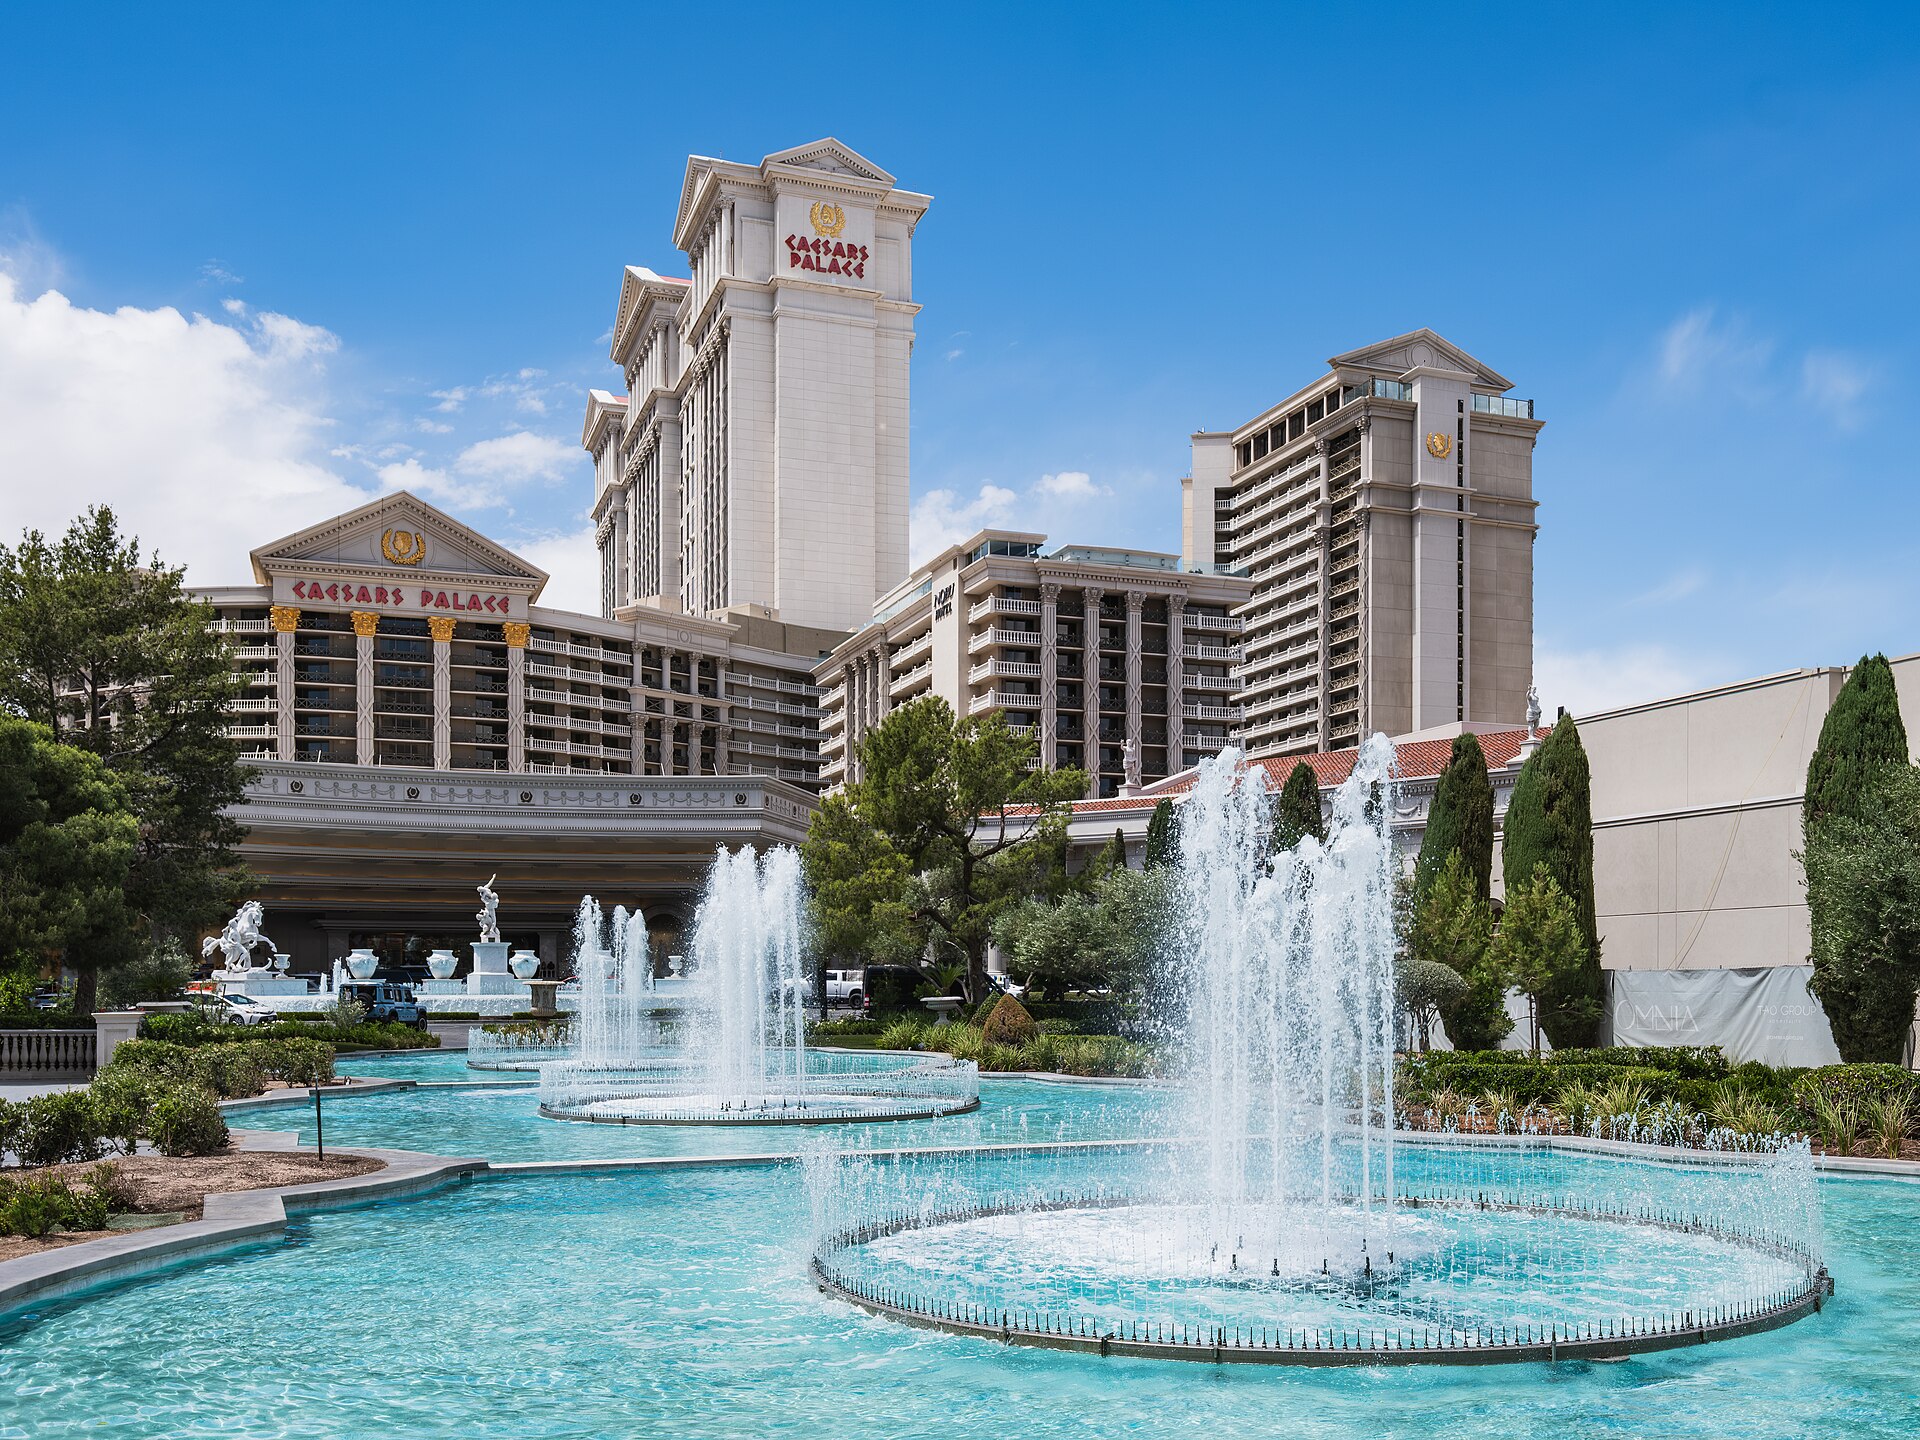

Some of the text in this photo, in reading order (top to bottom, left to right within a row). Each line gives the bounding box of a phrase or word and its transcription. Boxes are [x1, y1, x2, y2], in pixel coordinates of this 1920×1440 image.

[784, 233, 870, 262] CAESARS
[790, 252, 864, 279] PALACE
[292, 580, 510, 614] CAESARS PALACE
[933, 582, 956, 609] NOBU
[1615, 999, 1700, 1032] OMNIA
[1757, 1005, 1817, 1016] TAO GROUP
